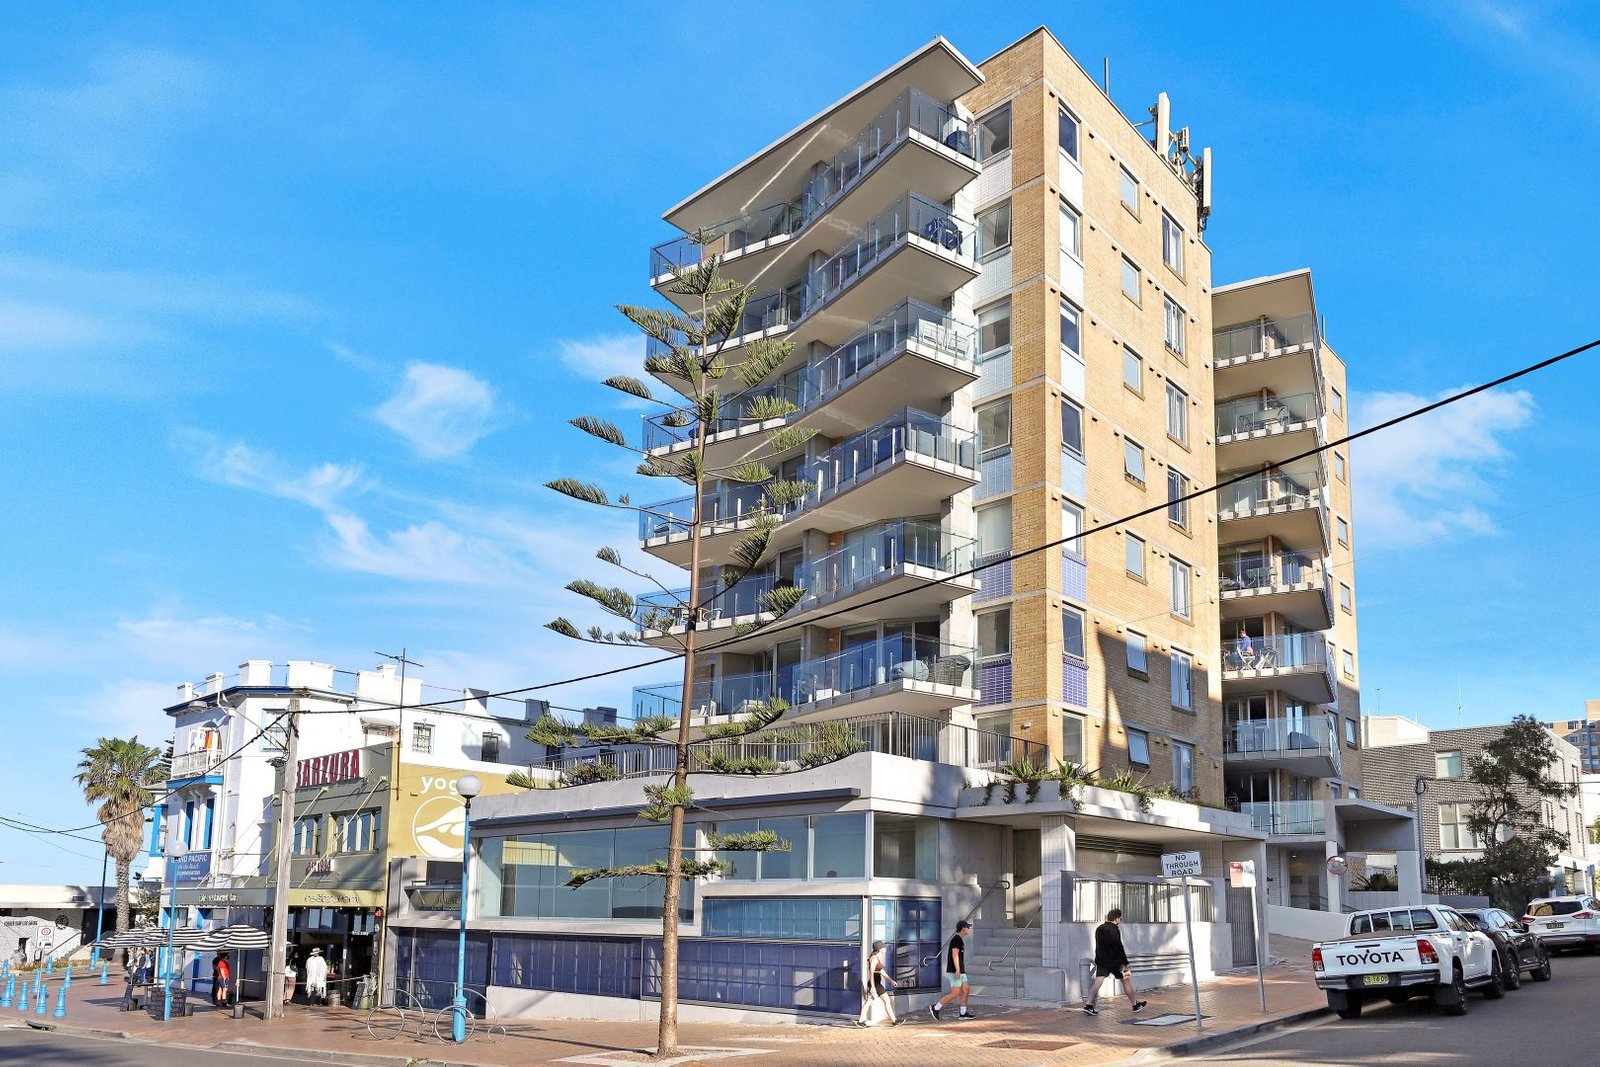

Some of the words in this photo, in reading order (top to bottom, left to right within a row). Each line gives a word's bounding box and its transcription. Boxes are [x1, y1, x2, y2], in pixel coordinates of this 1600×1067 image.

[420, 776, 459, 795] yog
[1165, 860, 1199, 870] THROUGH
[1336, 951, 1404, 966] TOYOTA
